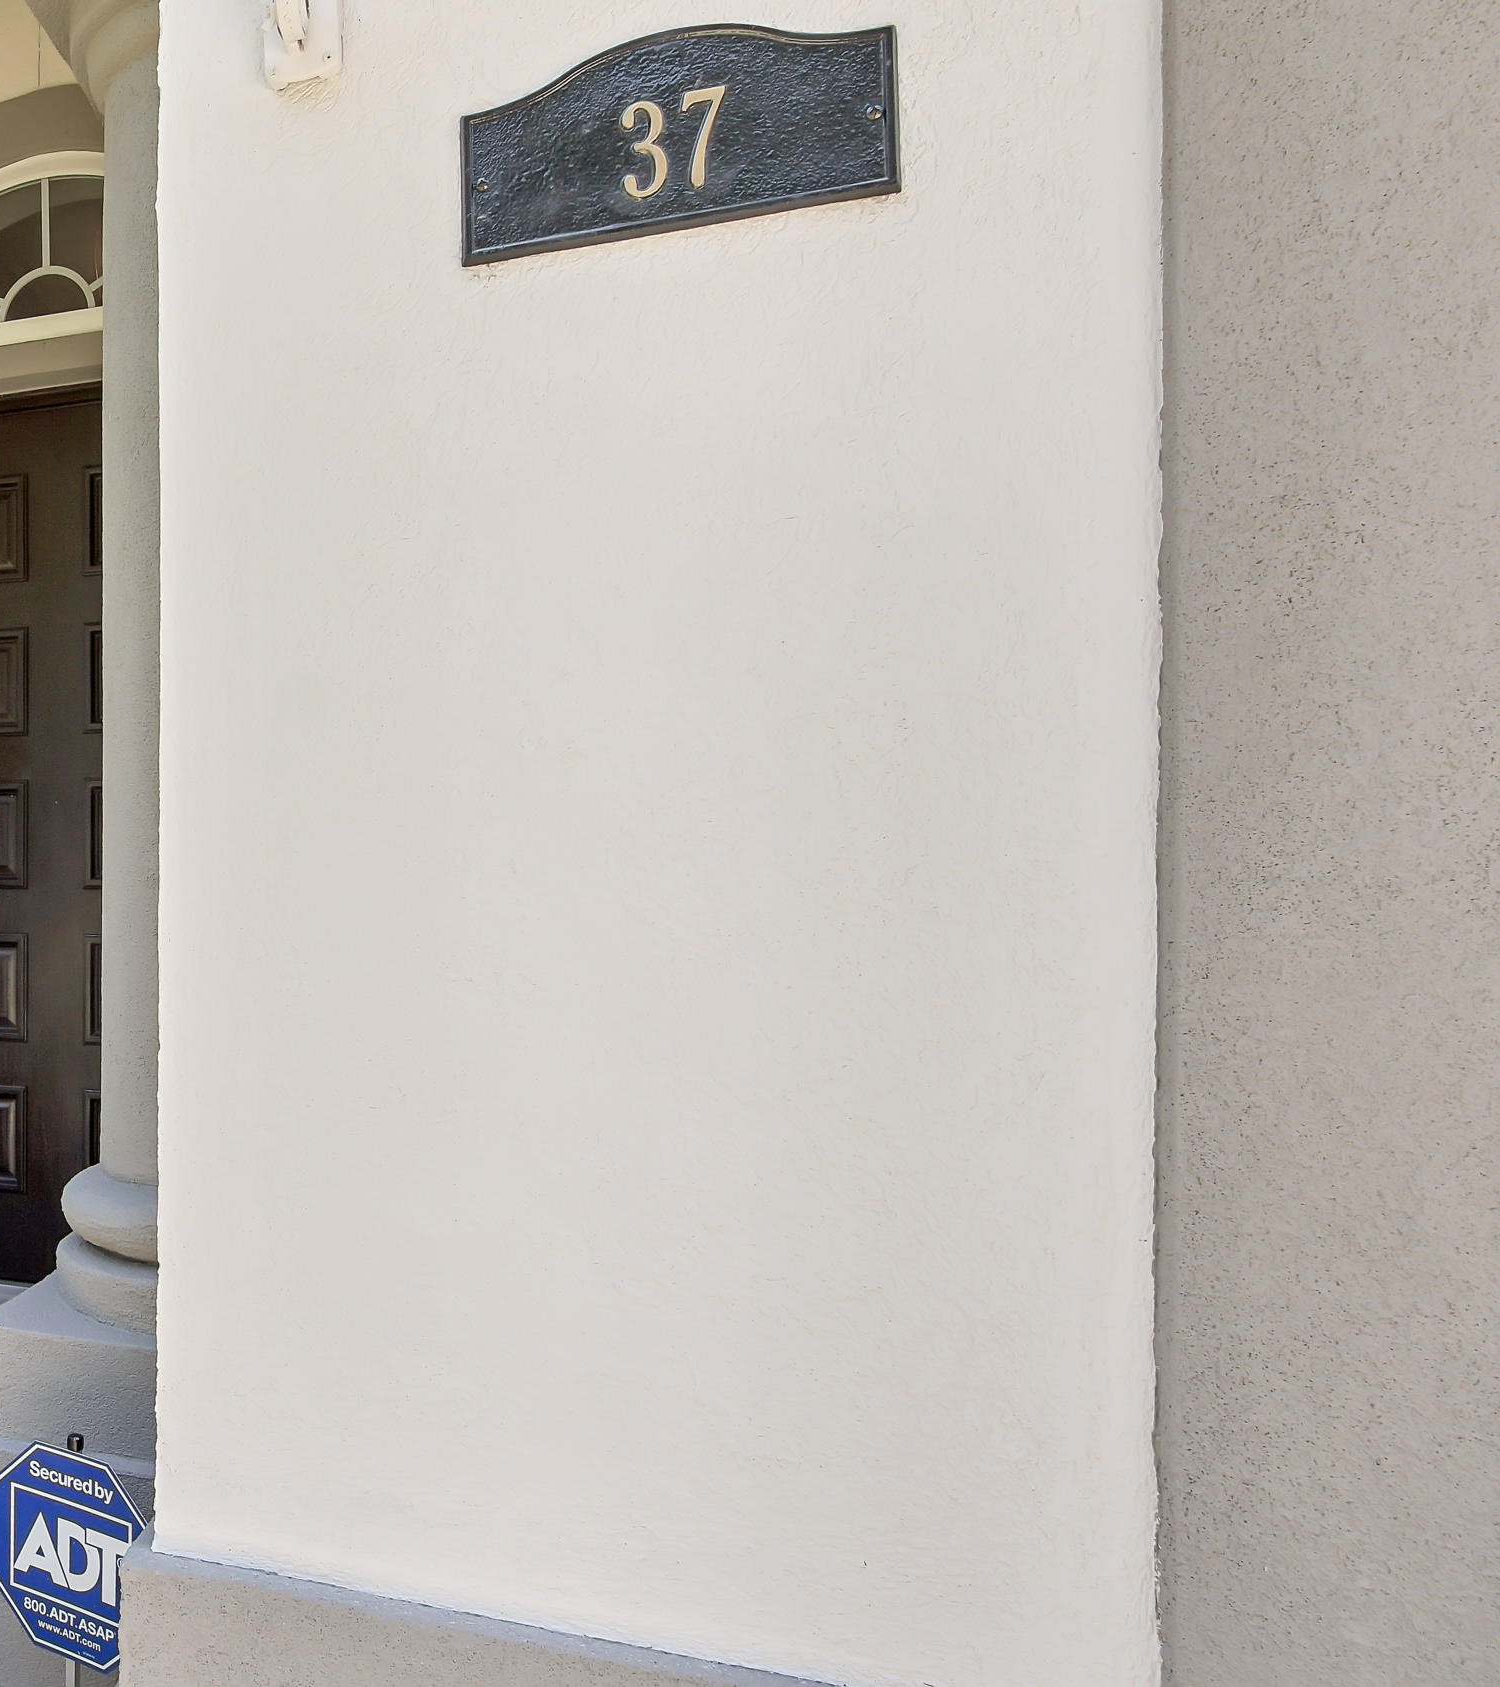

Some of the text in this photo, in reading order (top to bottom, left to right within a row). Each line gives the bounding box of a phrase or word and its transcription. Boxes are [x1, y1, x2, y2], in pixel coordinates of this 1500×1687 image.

[621, 85, 726, 200] 37
[29, 1460, 114, 1505] Secured by
[13, 1511, 129, 1607] ADT
[23, 1596, 116, 1642] 800.ADT.ASAP
[38, 1618, 101, 1652] www.ADT.com
